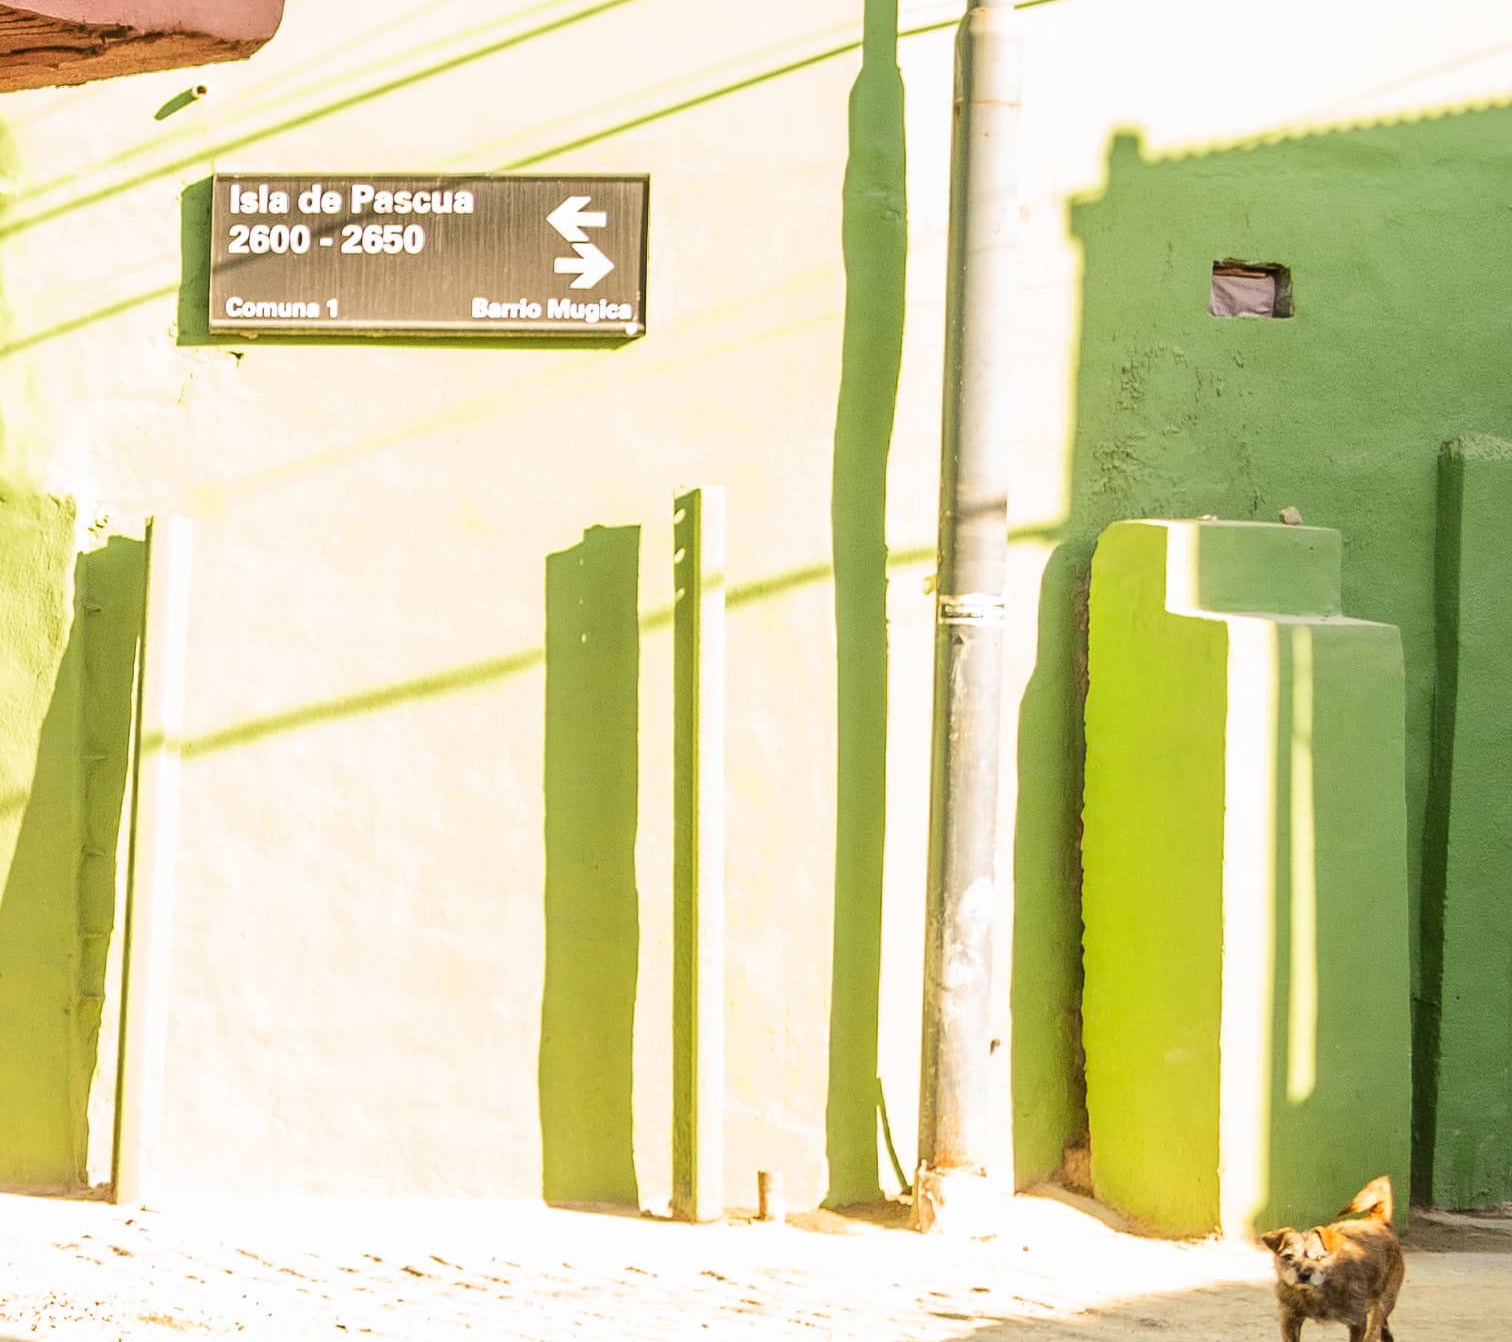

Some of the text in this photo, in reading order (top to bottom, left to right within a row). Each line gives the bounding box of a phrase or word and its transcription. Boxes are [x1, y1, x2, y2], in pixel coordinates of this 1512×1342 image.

[229, 183, 475, 215] Isla de Pascua
[227, 223, 426, 255] 2600 - 2650
[224, 295, 339, 319] Comuna 1
[470, 296, 633, 324] Barrio Mugica
